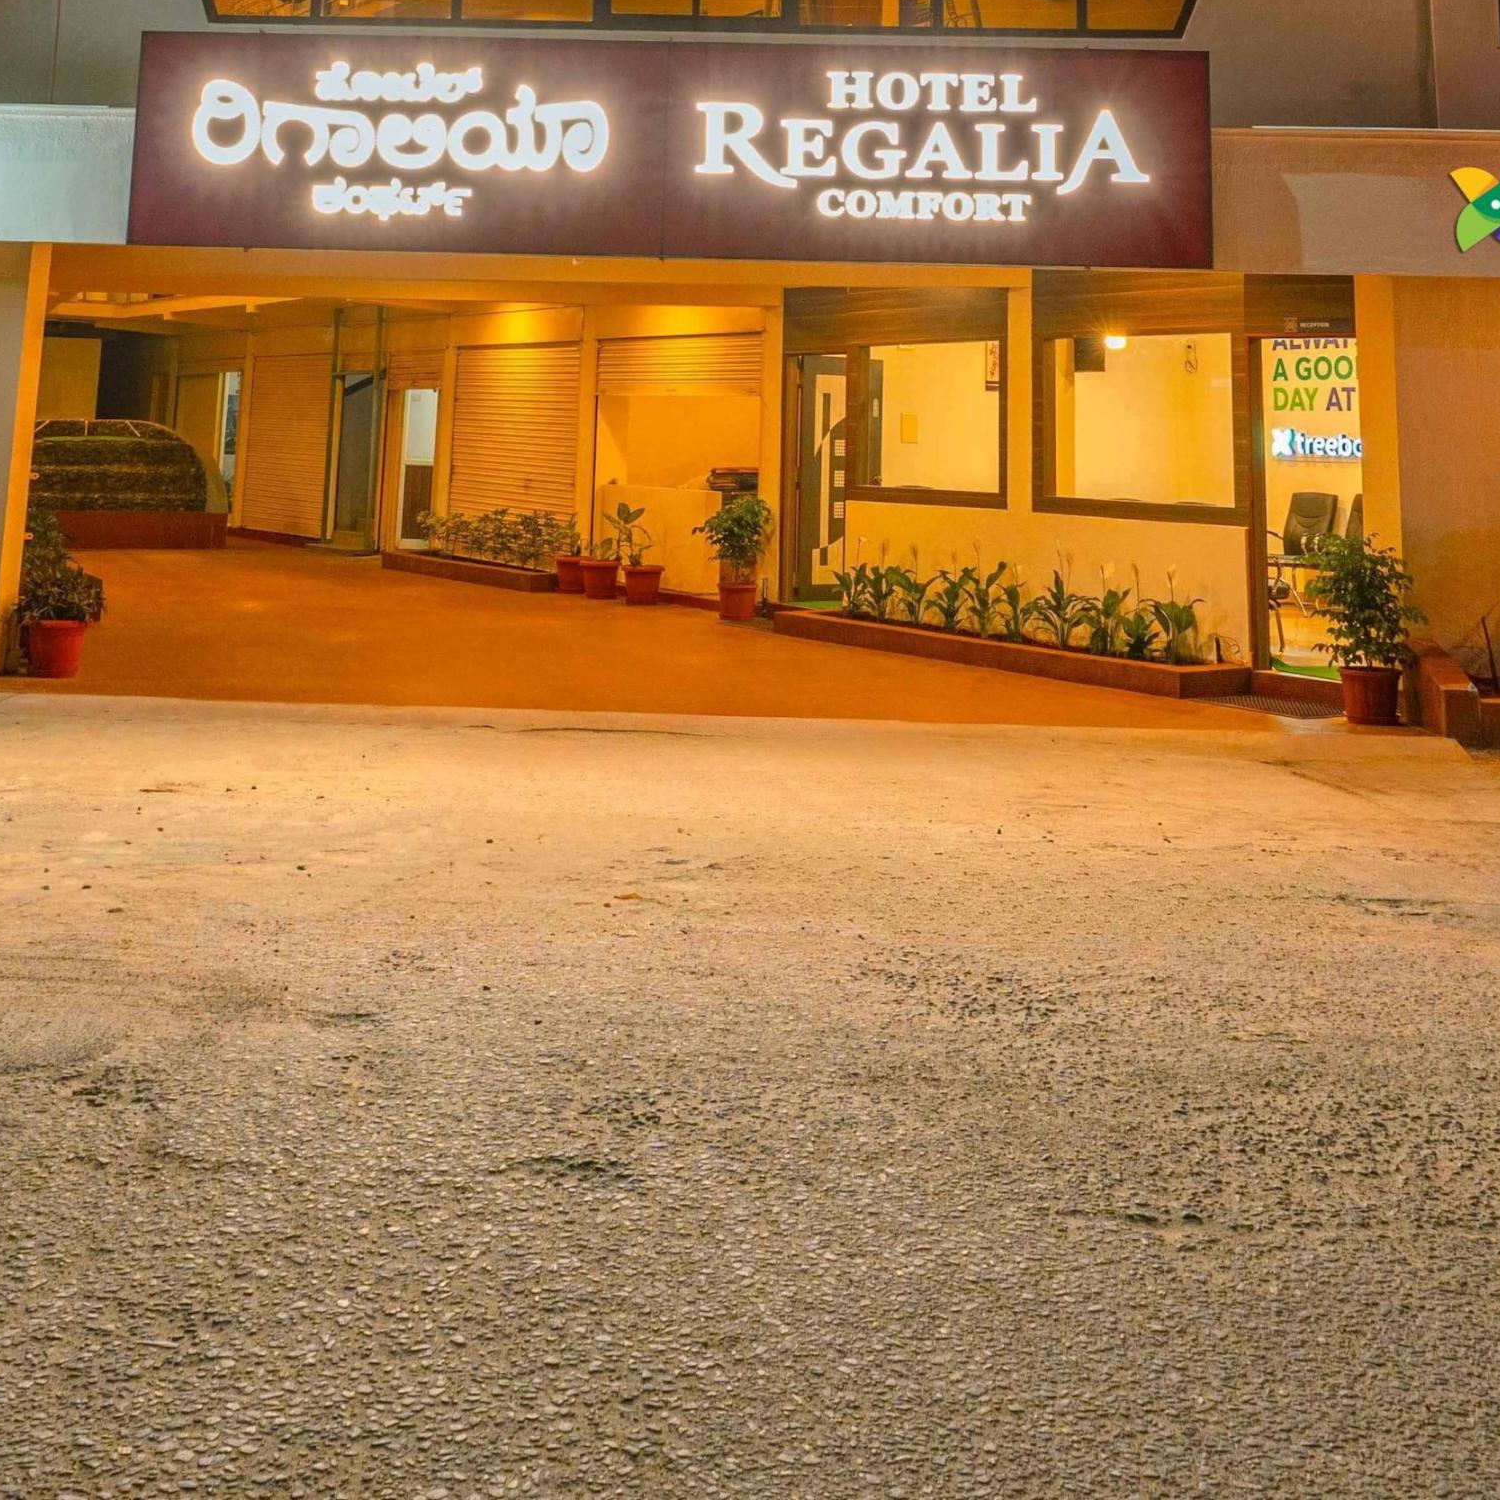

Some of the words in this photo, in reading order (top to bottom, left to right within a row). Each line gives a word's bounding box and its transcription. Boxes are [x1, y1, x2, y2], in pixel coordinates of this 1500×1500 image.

[826, 71, 1037, 112] HOTEL
[695, 102, 1150, 194] REGALIA
[816, 189, 1032, 221] COMFORT
[1273, 358, 1289, 381] A
[1295, 355, 1359, 381] GOO
[1273, 387, 1318, 412] DAY
[1325, 387, 1356, 412] AT
